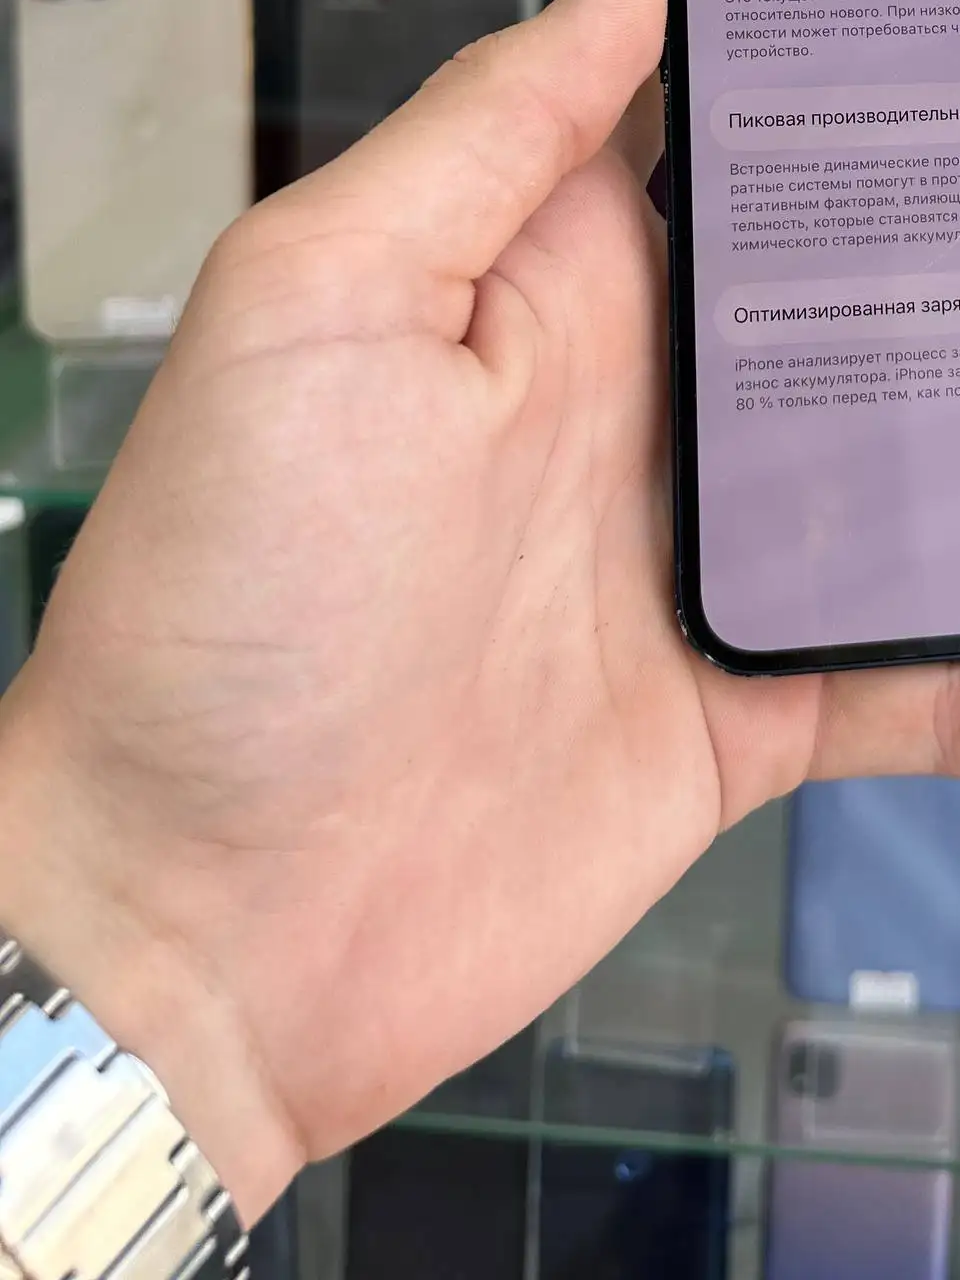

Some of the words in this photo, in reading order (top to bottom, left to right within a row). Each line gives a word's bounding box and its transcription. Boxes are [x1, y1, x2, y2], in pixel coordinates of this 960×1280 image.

[725, 9, 826, 24] относительно
[830, 8, 882, 19] нового.
[887, 5, 916, 19] При
[725, 29, 787, 41] емкости
[791, 27, 838, 38] может
[841, 23, 947, 39] потребоваться
[726, 44, 813, 62] устройство.
[729, 112, 805, 129] Пиковая
[729, 162, 820, 177] Встроенные
[823, 157, 930, 174] динамические
[730, 182, 784, 197] ратные
[788, 179, 852, 192] системы
[856, 176, 916, 190] помогут
[919, 176, 928, 187] в
[731, 199, 820, 213] негативным
[823, 196, 899, 211] факторам,
[731, 219, 809, 233] тельность,
[813, 215, 875, 229] которые
[878, 212, 958, 225] становятся
[731, 237, 828, 252] химического
[832, 233, 899, 248] старения
[734, 301, 915, 324] Оптимизированная
[735, 357, 784, 372] iPhone
[787, 352, 882, 369] анализирует
[885, 349, 947, 365] процесс
[735, 378, 779, 392] износ
[783, 372, 891, 390] аккумулятора.
[895, 367, 943, 381] iPhone
[735, 397, 755, 411] 80
[759, 395, 774, 409] %
[777, 395, 828, 408] только
[832, 391, 878, 406] перед
[881, 389, 912, 402] тем,
[917, 388, 941, 399] как
